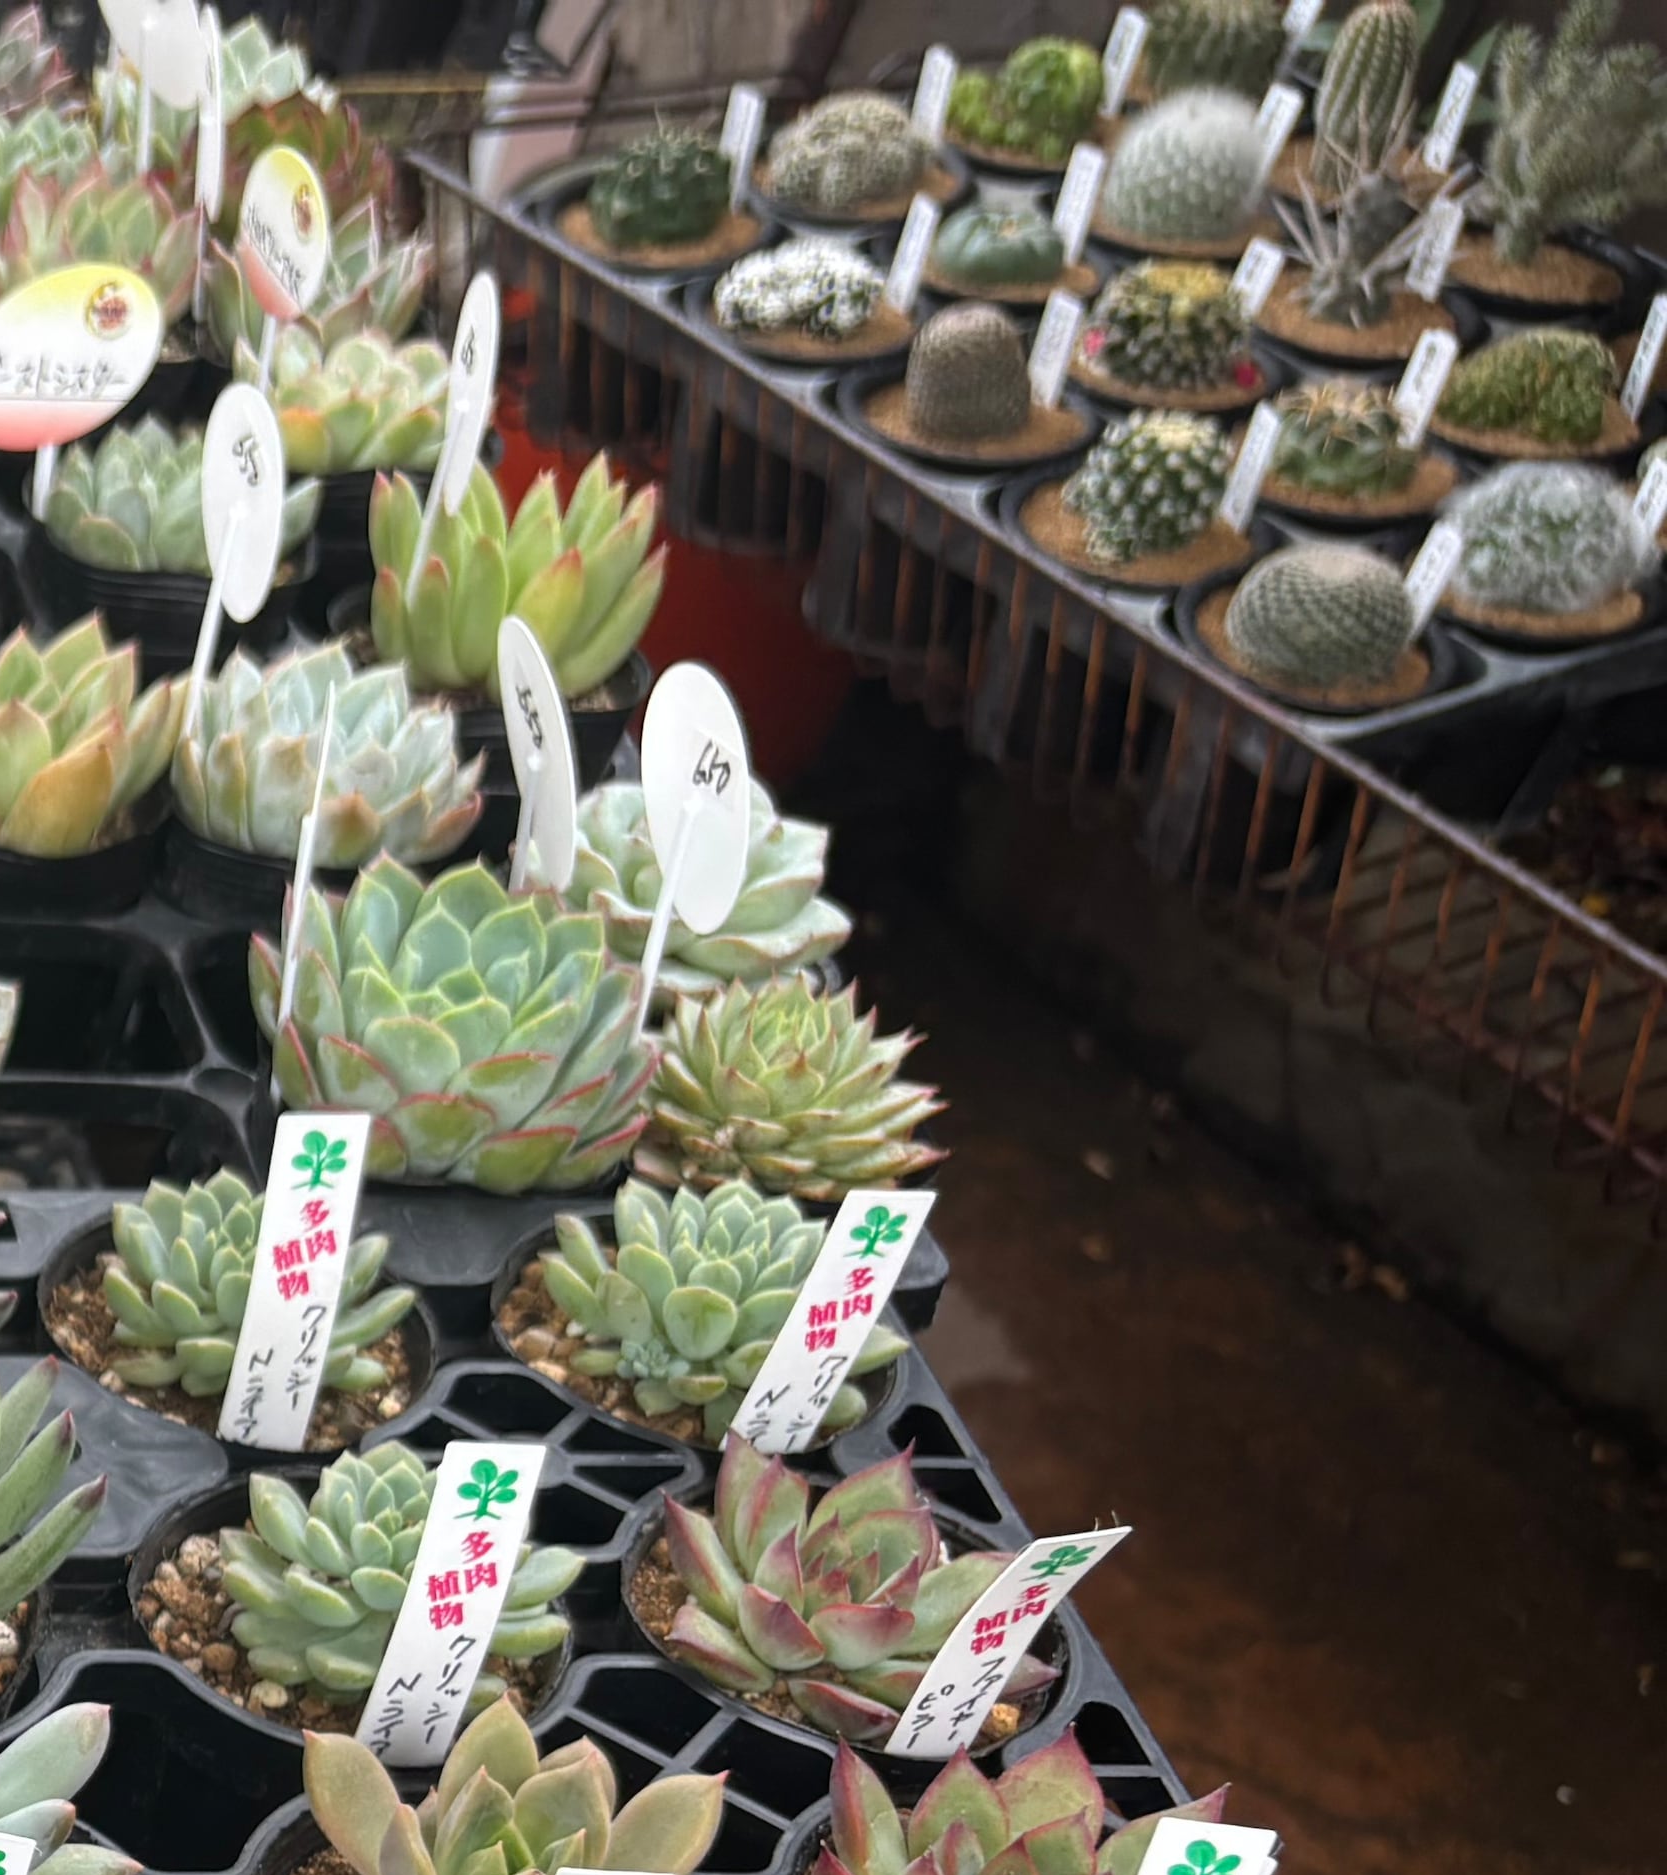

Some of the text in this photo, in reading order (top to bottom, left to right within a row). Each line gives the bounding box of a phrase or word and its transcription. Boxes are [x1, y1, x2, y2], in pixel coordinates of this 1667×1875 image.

[691, 737, 732, 795] 650
[273, 1200, 337, 1300] 多肉植物
[806, 1268, 874, 1352] 多肉植物
[428, 1532, 498, 1630] 多肉植物
[972, 1586, 1047, 1654] 多肉植物
